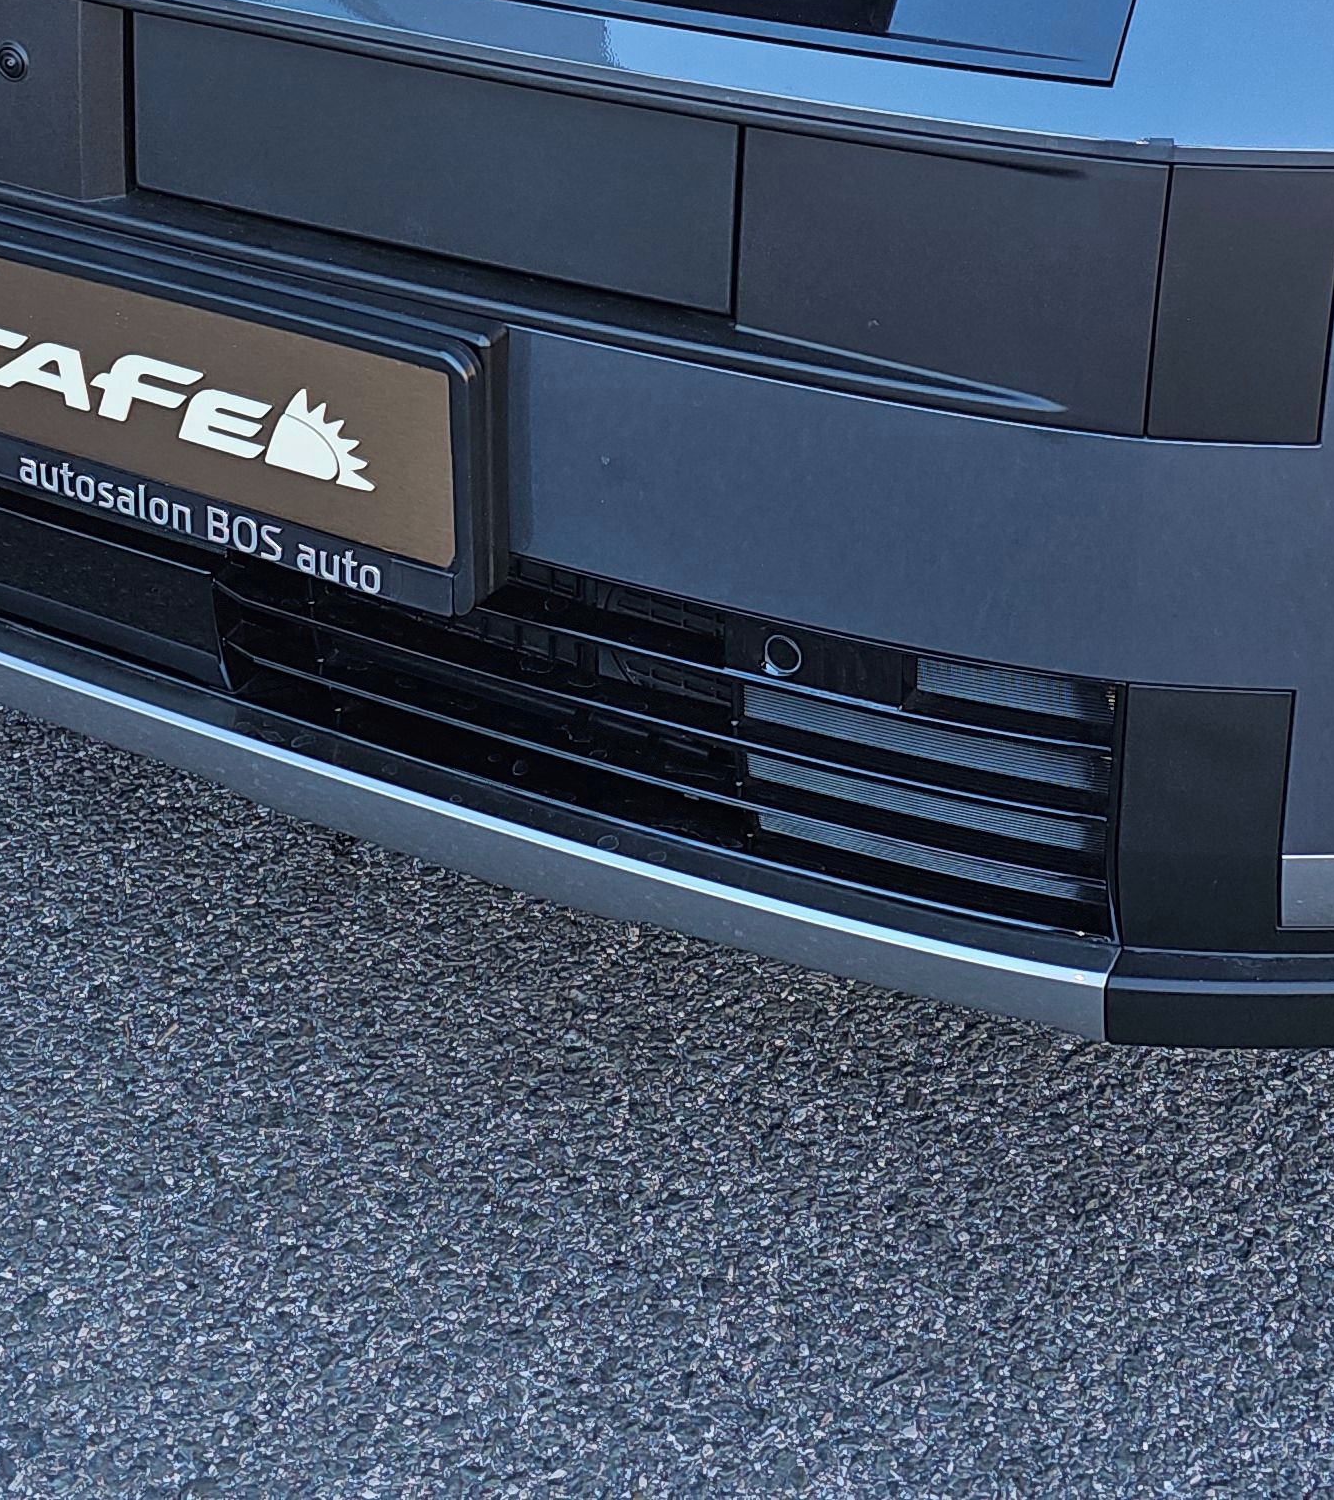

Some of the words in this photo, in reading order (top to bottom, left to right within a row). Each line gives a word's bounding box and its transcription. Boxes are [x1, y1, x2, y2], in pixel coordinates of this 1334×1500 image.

[18, 455, 192, 535] autosalon
[206, 505, 284, 563] BOS
[296, 542, 382, 595] auto
